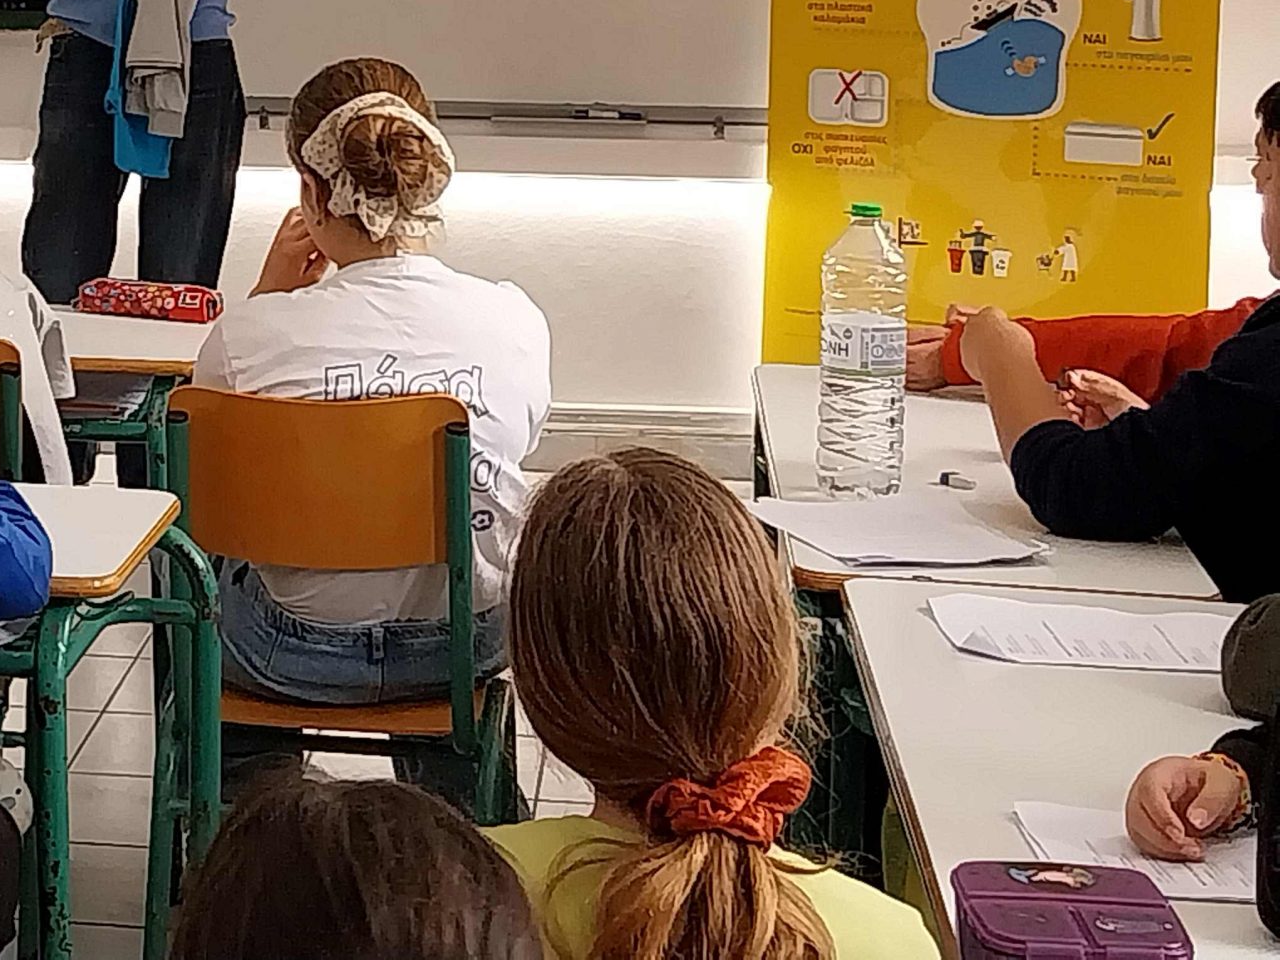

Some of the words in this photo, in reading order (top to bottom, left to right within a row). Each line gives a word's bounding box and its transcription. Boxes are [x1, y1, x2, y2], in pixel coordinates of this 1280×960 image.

[1083, 34, 1106, 44] ΝΑΙ
[791, 143, 814, 154] ΟΧΙ
[1146, 154, 1172, 166] ΝΑΙ
